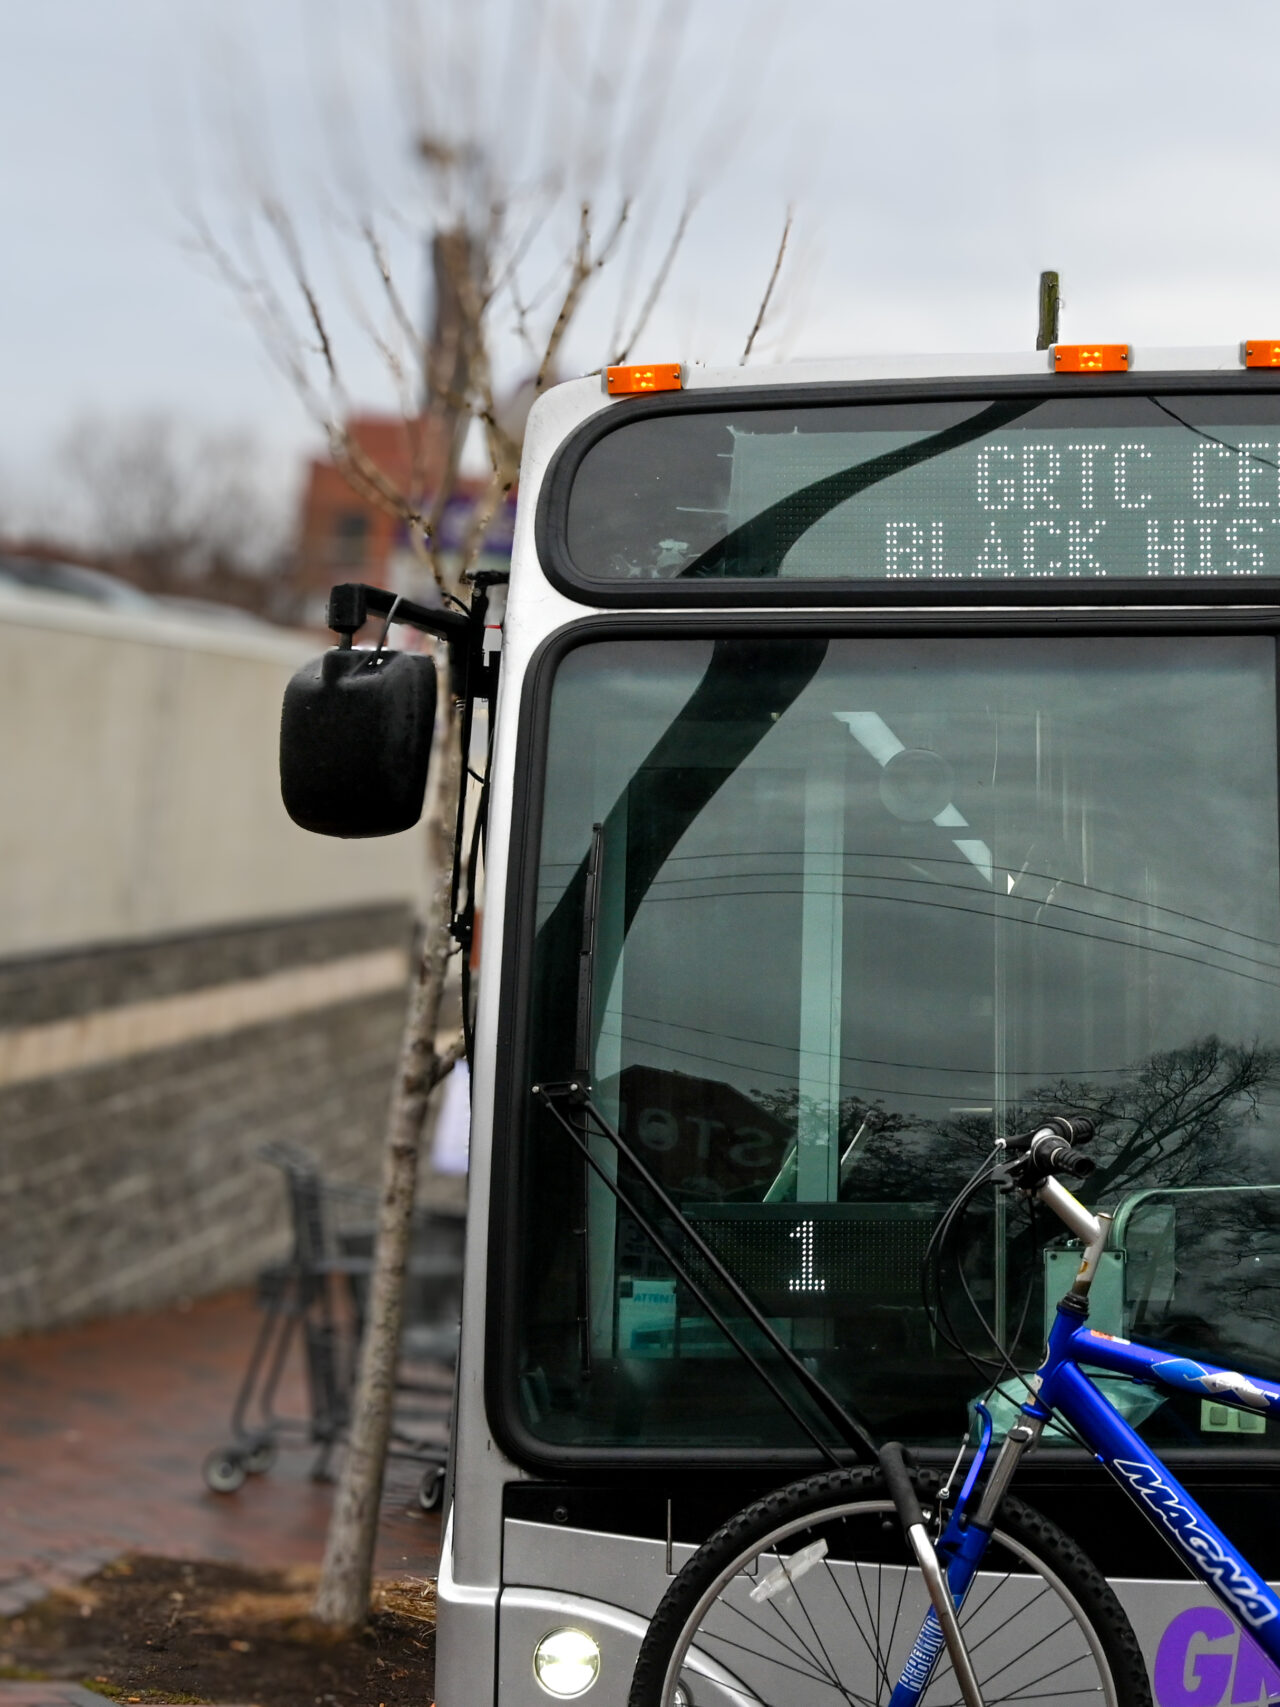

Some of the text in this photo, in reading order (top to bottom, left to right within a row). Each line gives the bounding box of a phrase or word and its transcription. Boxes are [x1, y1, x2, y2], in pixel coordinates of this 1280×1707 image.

[977, 444, 1152, 509] GRTC
[886, 520, 1107, 577] BLACK
[789, 1220, 826, 1291] 1
[1113, 1459, 1278, 1627] MAGNA
